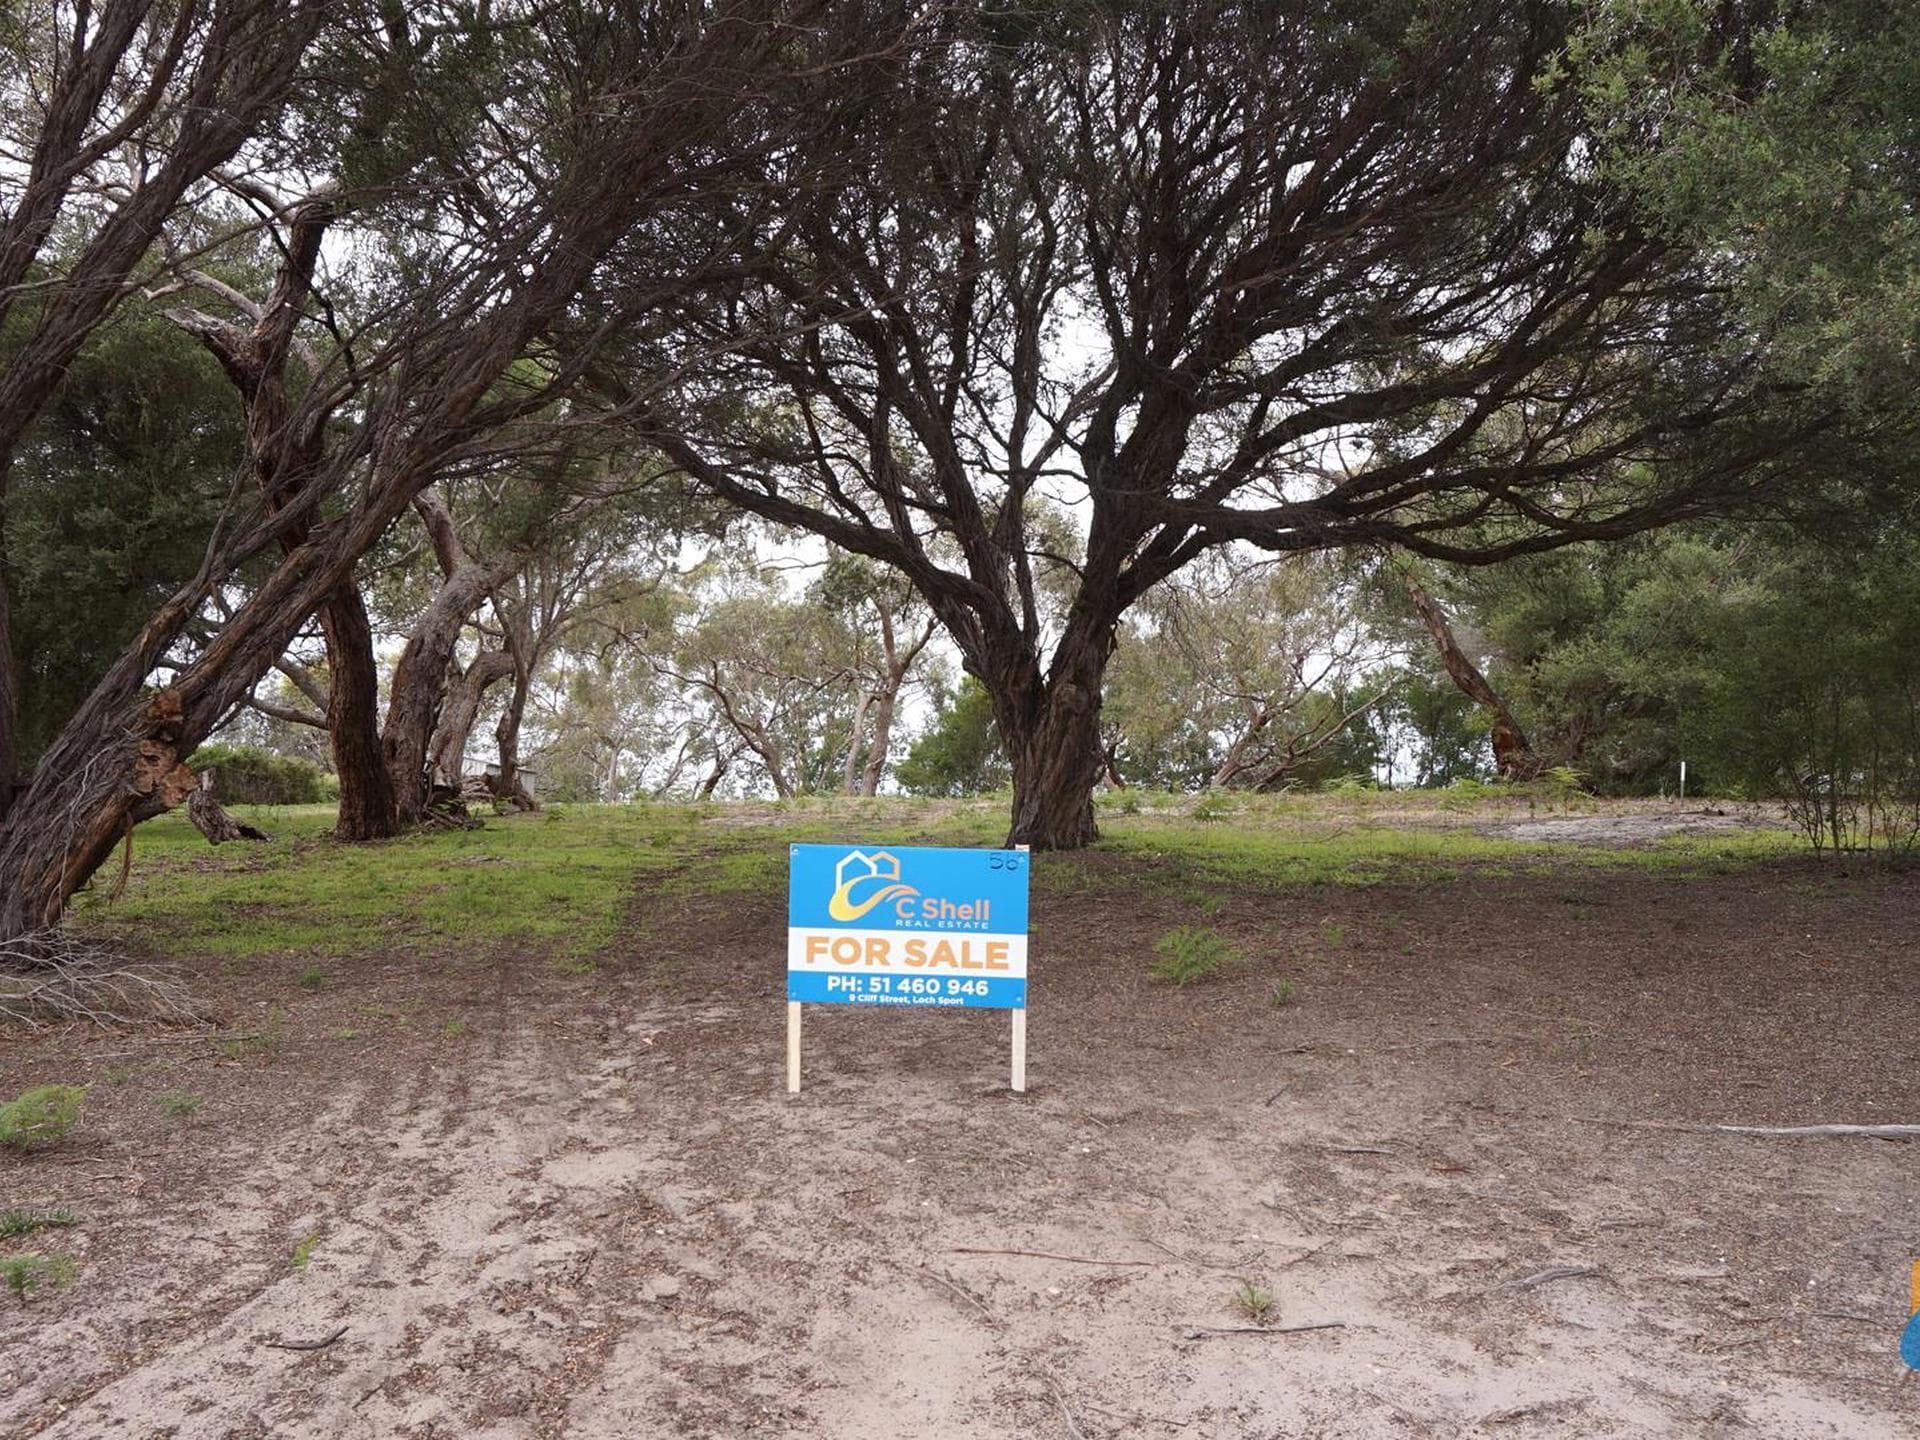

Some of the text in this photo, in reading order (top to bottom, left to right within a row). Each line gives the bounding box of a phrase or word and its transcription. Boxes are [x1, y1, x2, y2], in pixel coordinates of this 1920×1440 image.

[895, 897, 990, 920] C Shell
[895, 919, 989, 929] REAL ESTATE
[805, 936, 1010, 970] FOR SALE
[827, 975, 989, 996] PH: 51 460 946
[858, 994, 877, 1002] Cliff
[879, 995, 911, 1004] Street,
[912, 996, 936, 1004] Loch
[938, 996, 964, 1006] Sport
